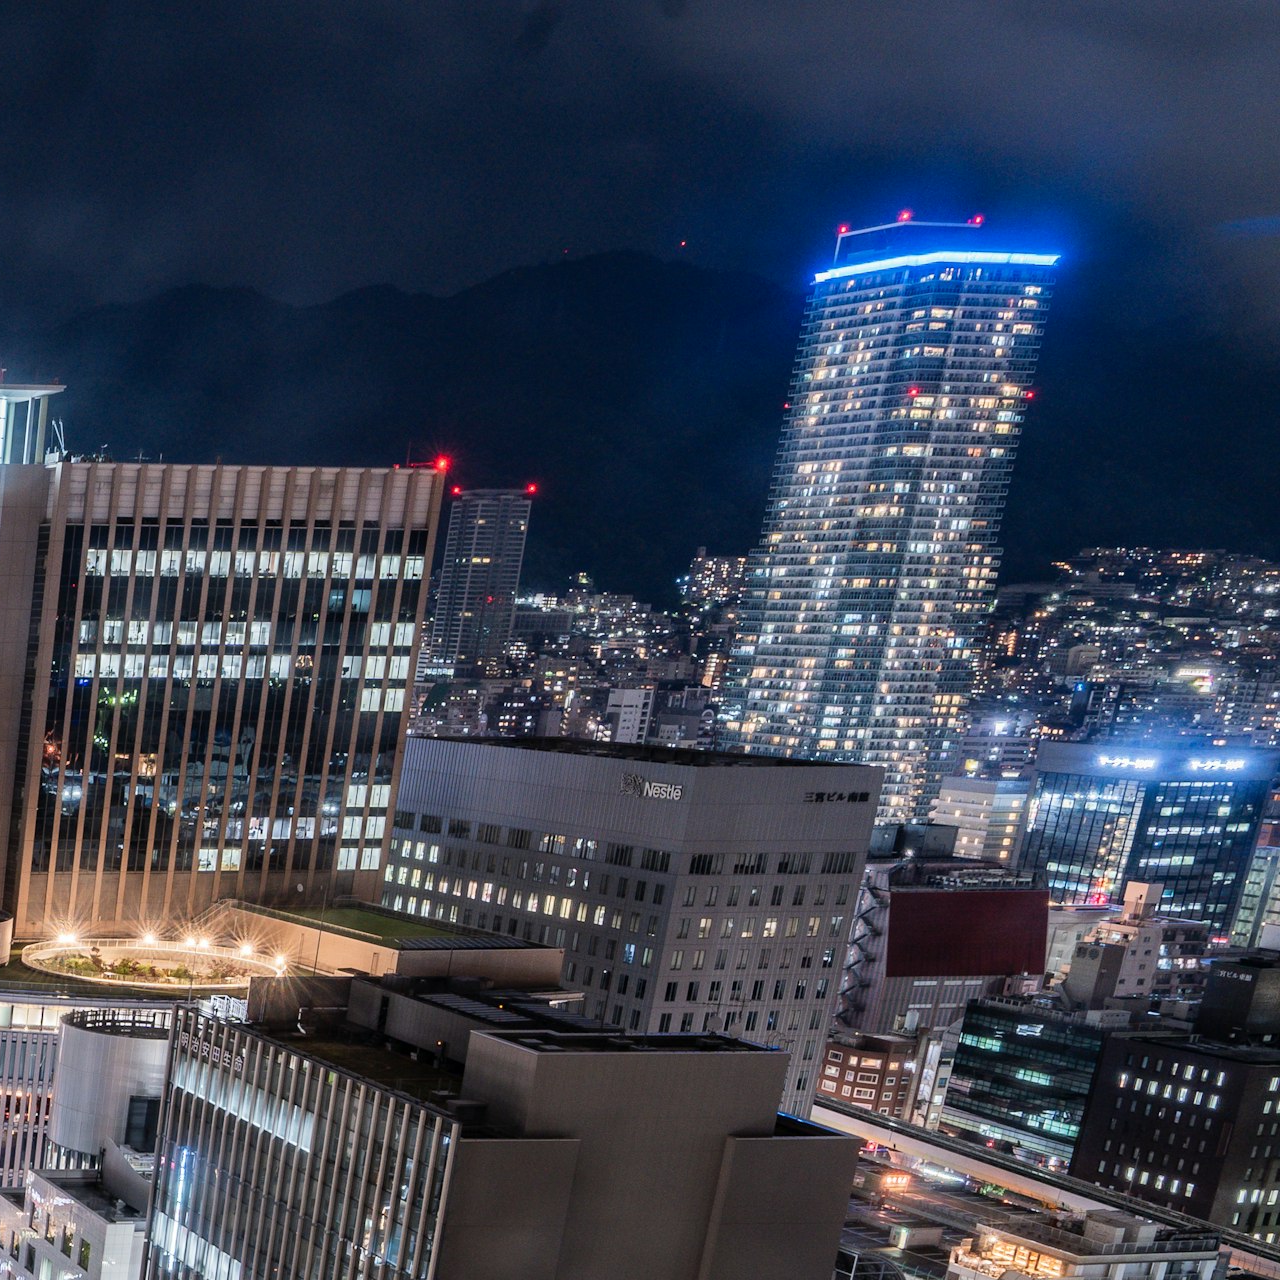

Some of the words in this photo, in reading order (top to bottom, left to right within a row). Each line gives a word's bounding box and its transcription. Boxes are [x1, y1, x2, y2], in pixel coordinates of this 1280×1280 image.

[643, 782, 683, 801] Nestlé
[803, 792, 871, 803] 三宮ビル南館
[181, 1032, 243, 1072] 明治安田生命
